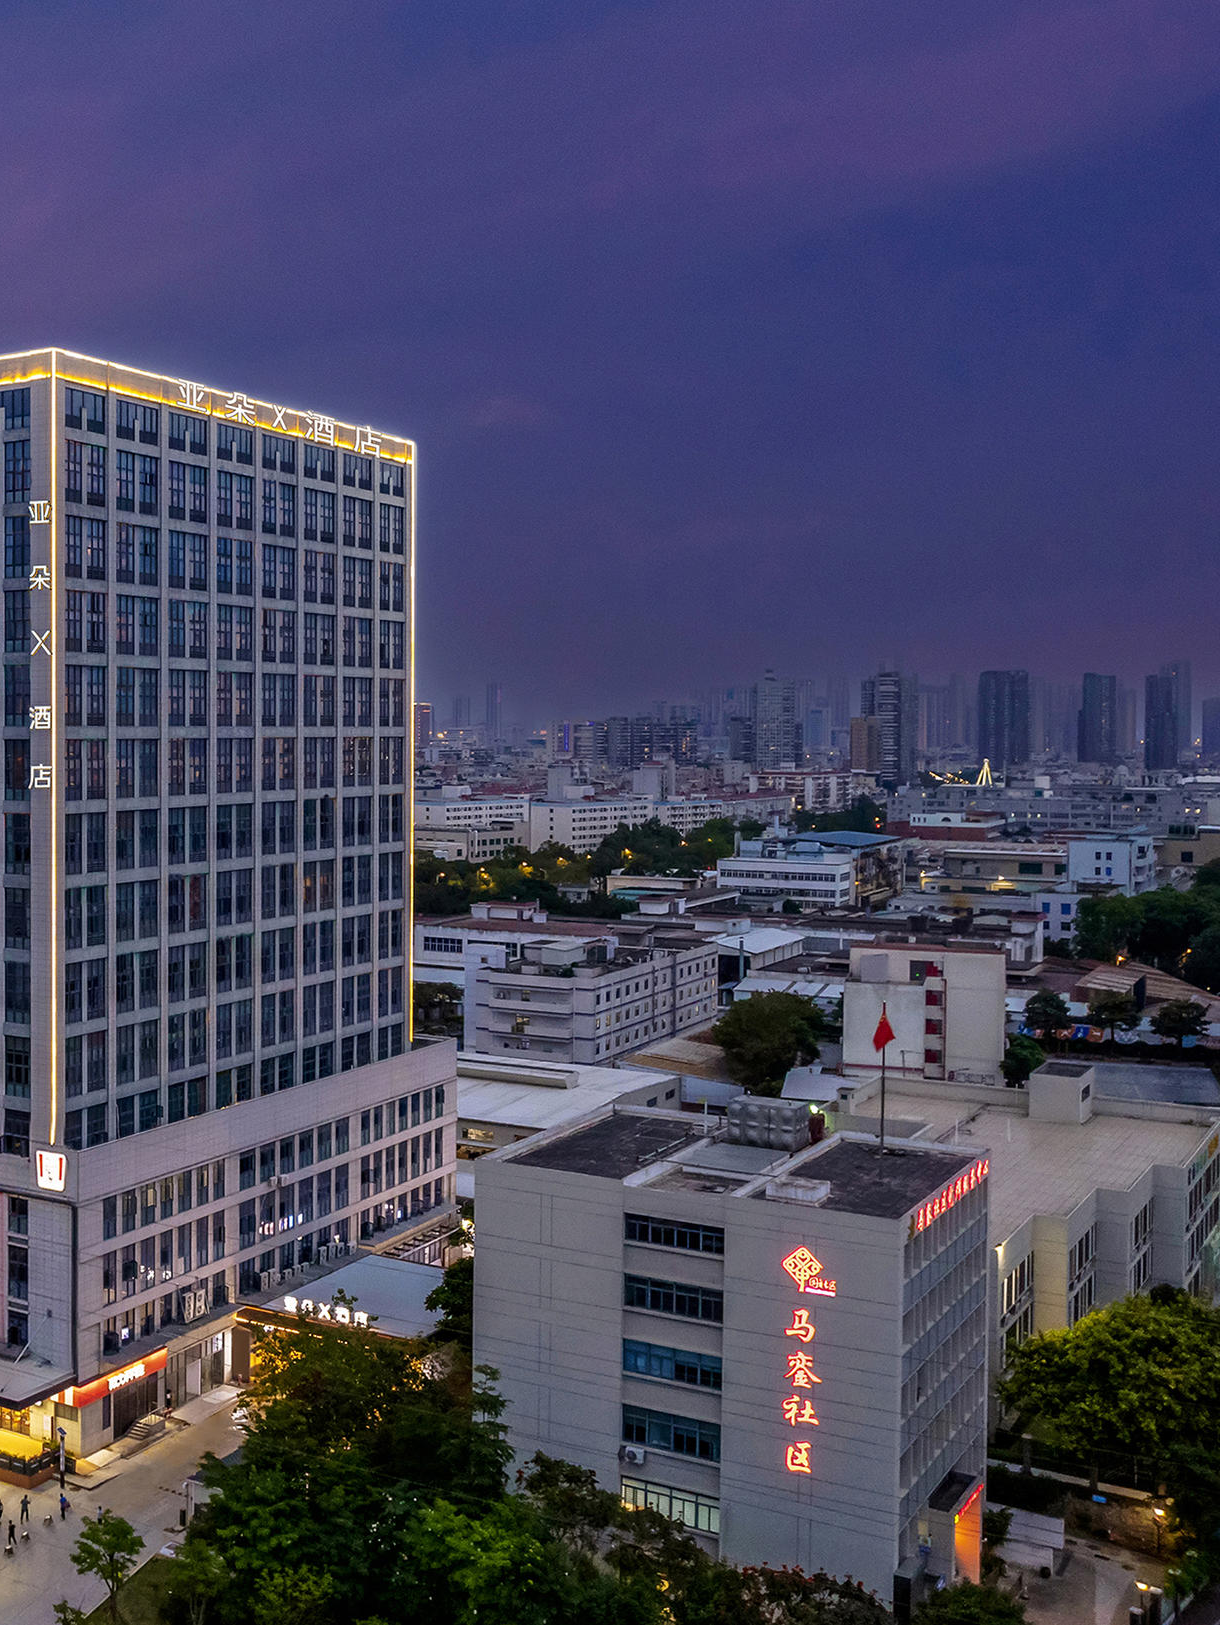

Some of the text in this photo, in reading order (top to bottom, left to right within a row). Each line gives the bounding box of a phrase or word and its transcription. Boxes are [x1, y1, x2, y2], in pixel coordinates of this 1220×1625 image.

[177, 378, 382, 458] 亚朵X酒店
[28, 500, 53, 789] 亚朵X酒店
